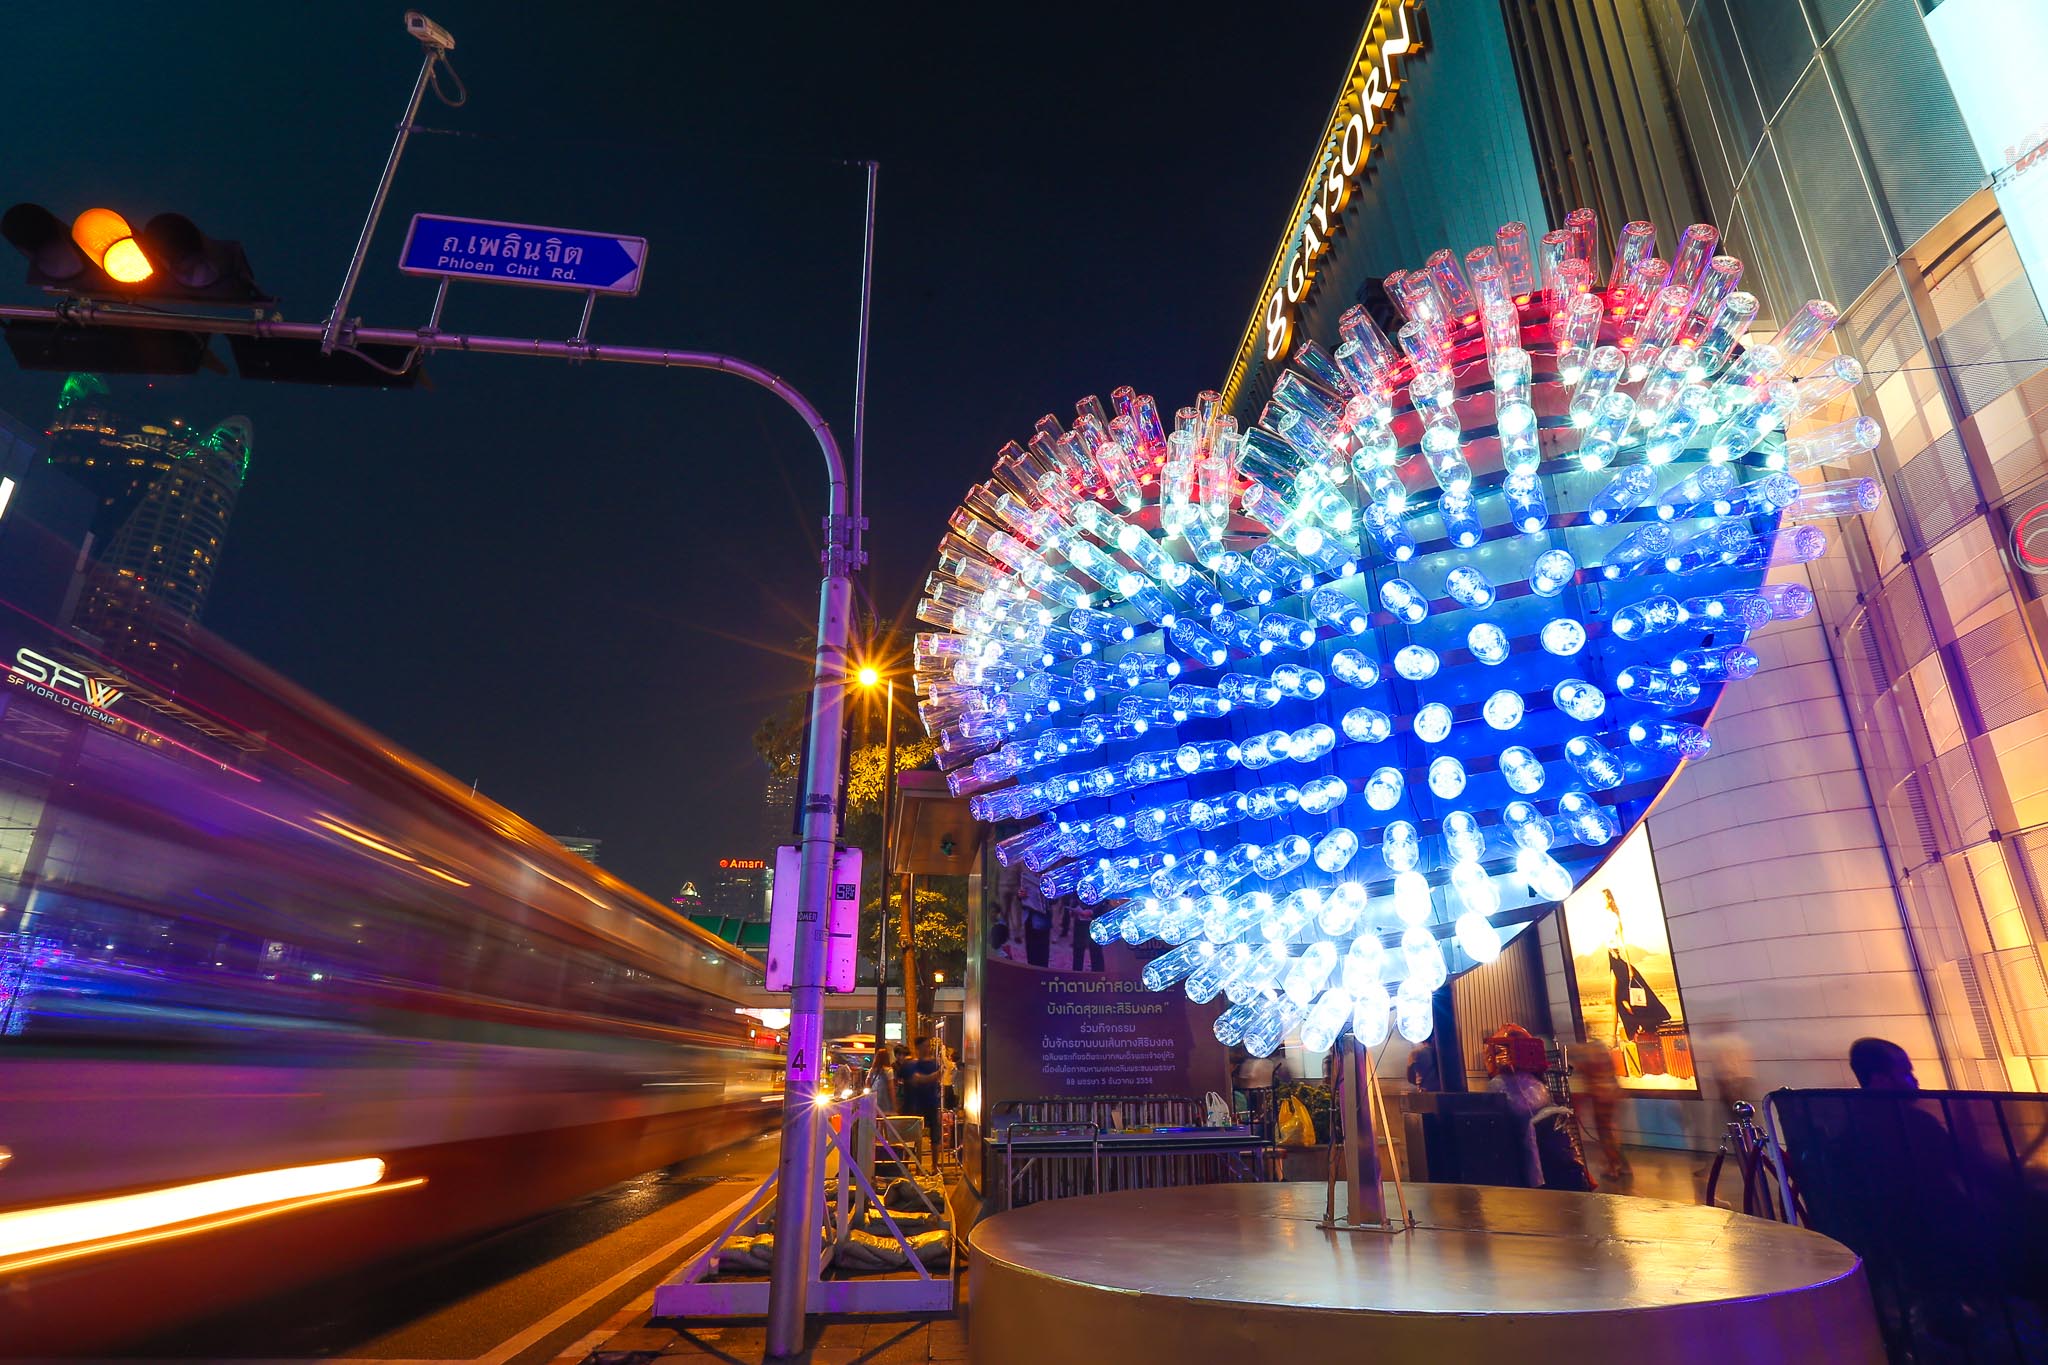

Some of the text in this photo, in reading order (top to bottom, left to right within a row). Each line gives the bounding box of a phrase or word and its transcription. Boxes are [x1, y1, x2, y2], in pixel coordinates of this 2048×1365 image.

[1288, 0, 1411, 304] GAYSORN
[442, 233, 583, 265] ถ.เพลินจิต
[437, 256, 577, 281] Phloen Chit Rd.
[7, 673, 116, 726] SF WORLD CINEMA
[729, 858, 764, 869] Amari
[1080, 1021, 1136, 1033] ร่วมกิจกรรม
[791, 1049, 807, 1073] 4
